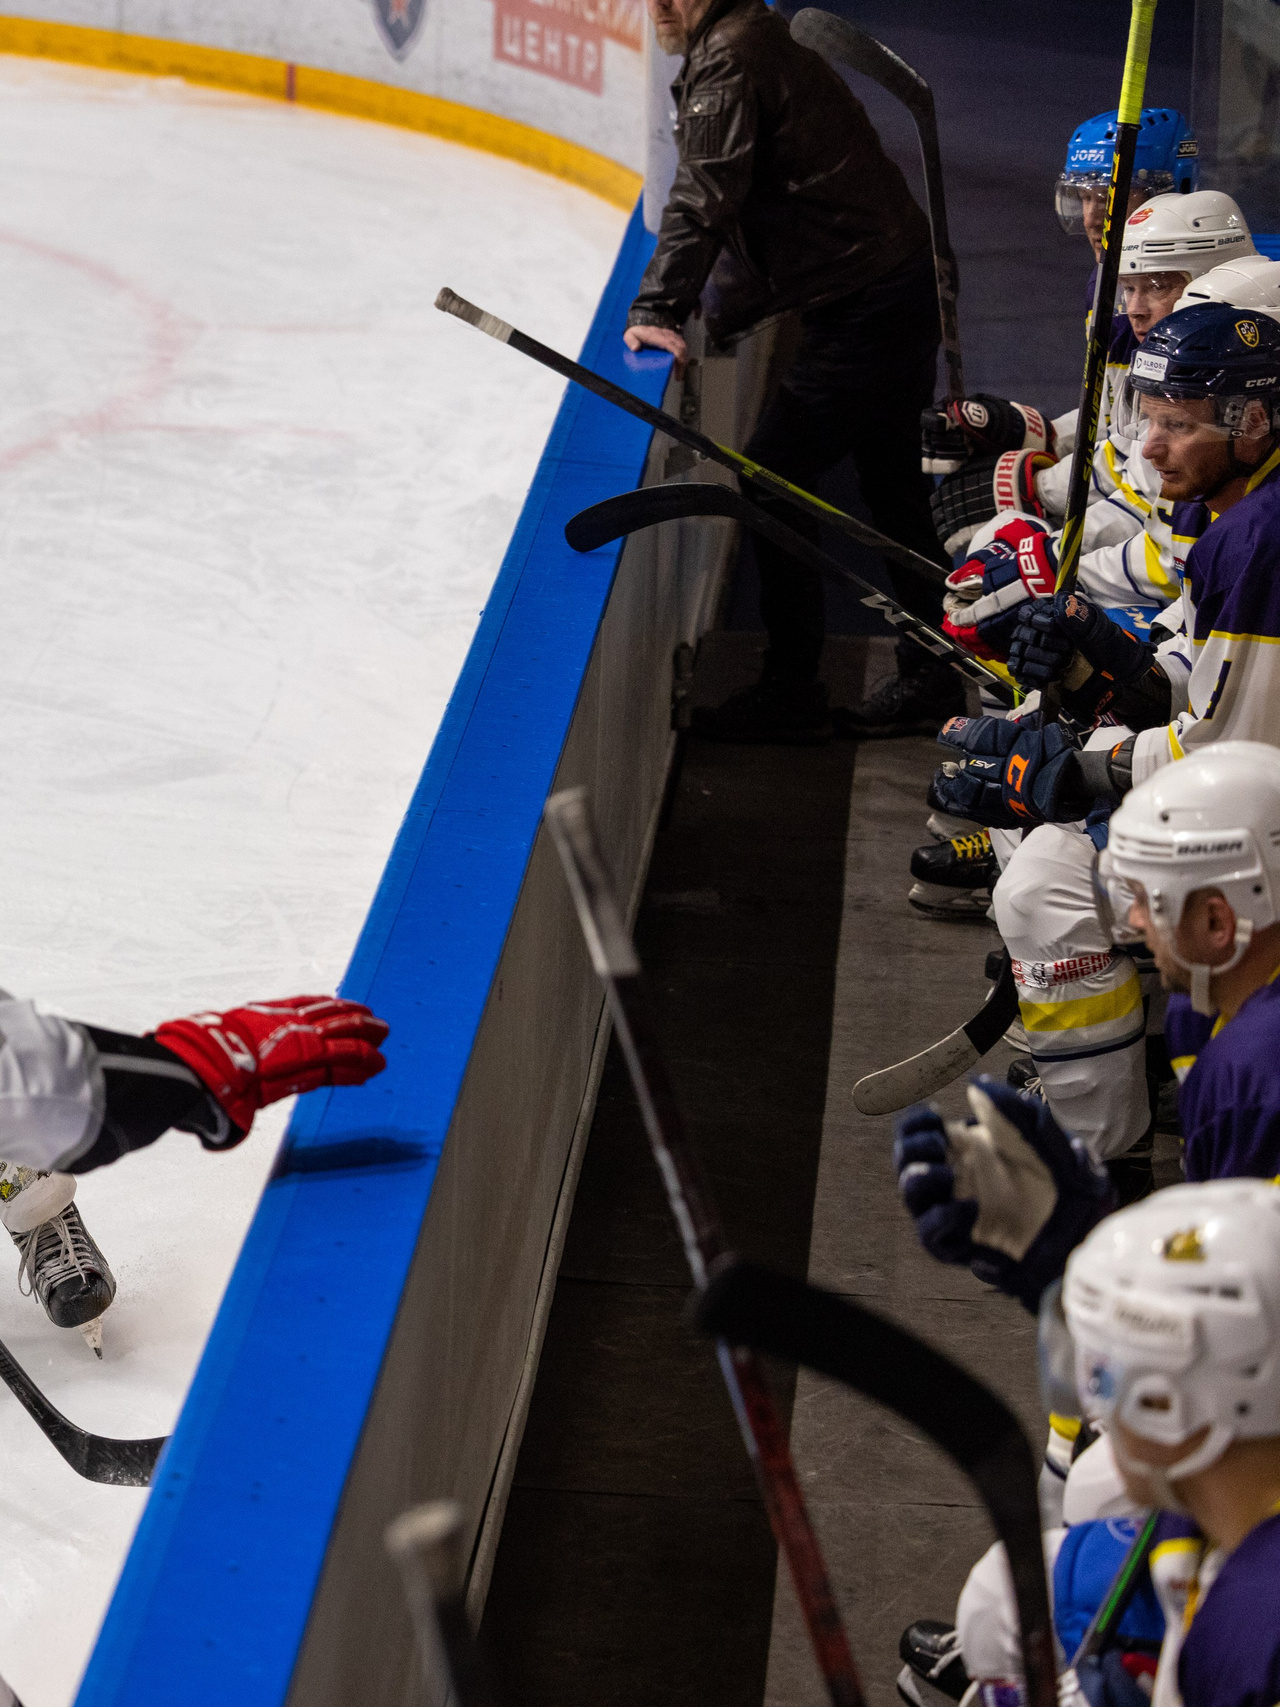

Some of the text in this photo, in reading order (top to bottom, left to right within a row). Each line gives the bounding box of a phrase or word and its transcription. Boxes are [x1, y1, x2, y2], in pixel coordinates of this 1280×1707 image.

[501, 14, 598, 82] ЦЕНТР
[1071, 149, 1106, 162] JOFA
[1121, 244, 1140, 252] UER
[1245, 376, 1278, 388] CCM
[1019, 536, 1054, 599] BAU
